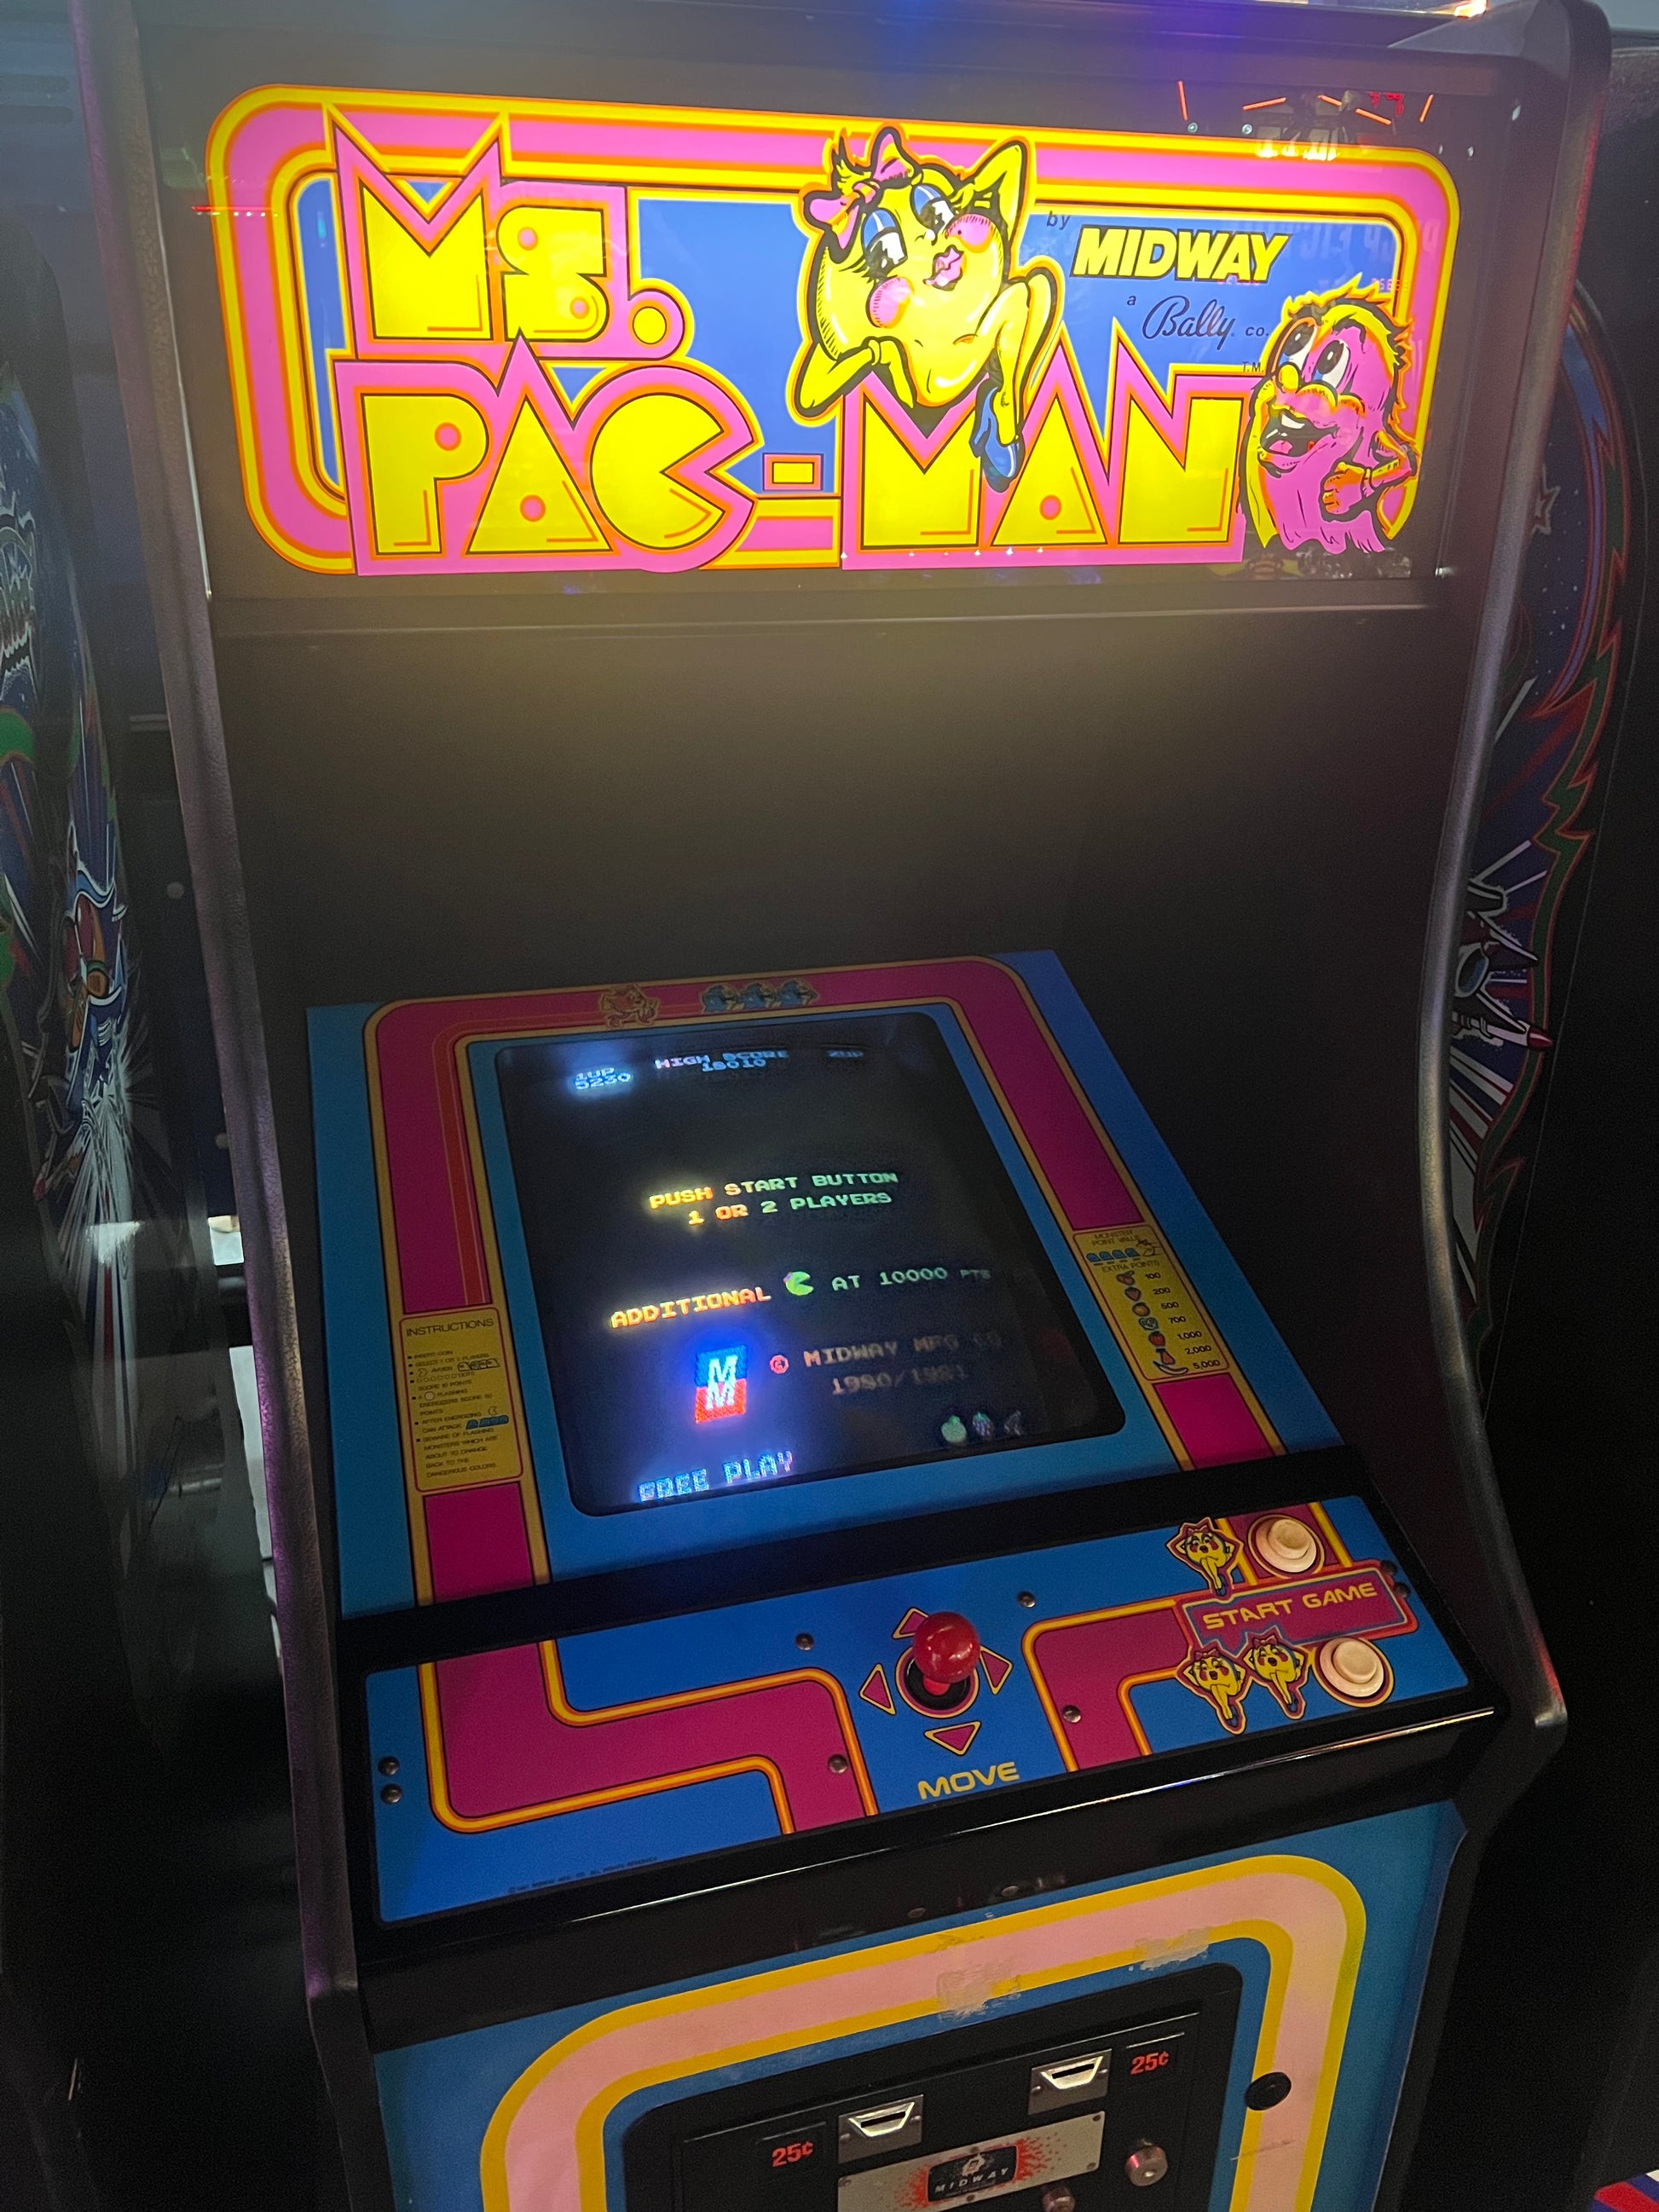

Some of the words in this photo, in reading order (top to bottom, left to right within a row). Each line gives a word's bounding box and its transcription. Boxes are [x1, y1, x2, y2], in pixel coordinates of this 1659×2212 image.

[1047, 211, 1070, 230] by
[1069, 224, 1293, 285] MIDWAY
[1126, 295, 1136, 306] a
[1142, 295, 1236, 350] Bally
[1245, 326, 1269, 337] co.
[348, 362, 1240, 564] PAC-MAN
[575, 1066, 616, 1079] 1UP
[655, 1054, 711, 1070] HIGH
[722, 1049, 789, 1061] SCORE
[649, 1187, 714, 1210] PUSH
[724, 1176, 798, 1196] START
[811, 1173, 899, 1187] BUTTON
[688, 1210, 704, 1226] 1
[714, 1204, 749, 1221] OR
[760, 1200, 778, 1214] 2
[789, 1193, 893, 1210] PLAYERS
[1145, 1272, 1161, 1280] 100
[610, 1286, 772, 1329] ADDITIONAL
[831, 1275, 860, 1291] AT
[879, 1267, 948, 1286] 10000
[1153, 1287, 1171, 1296] 200
[1160, 1301, 1180, 1309] 500
[407, 1318, 494, 1337] INSTRUCTIONS
[1168, 1315, 1187, 1324] 700
[1177, 1330, 1203, 1341] 1,000
[803, 1339, 899, 1368] MIDWAY
[1185, 1344, 1212, 1355] 2,000
[1193, 1359, 1221, 1370] 5,000
[723, 1450, 793, 1484] PLAY
[1202, 1597, 1294, 1630] START
[1302, 1580, 1378, 1610] GAME
[917, 1760, 1020, 1800] MOVE
[1130, 2050, 1170, 2076] 25¢
[772, 2140, 814, 2168] 25¢
[935, 2167, 1009, 2193] MIDWAY
